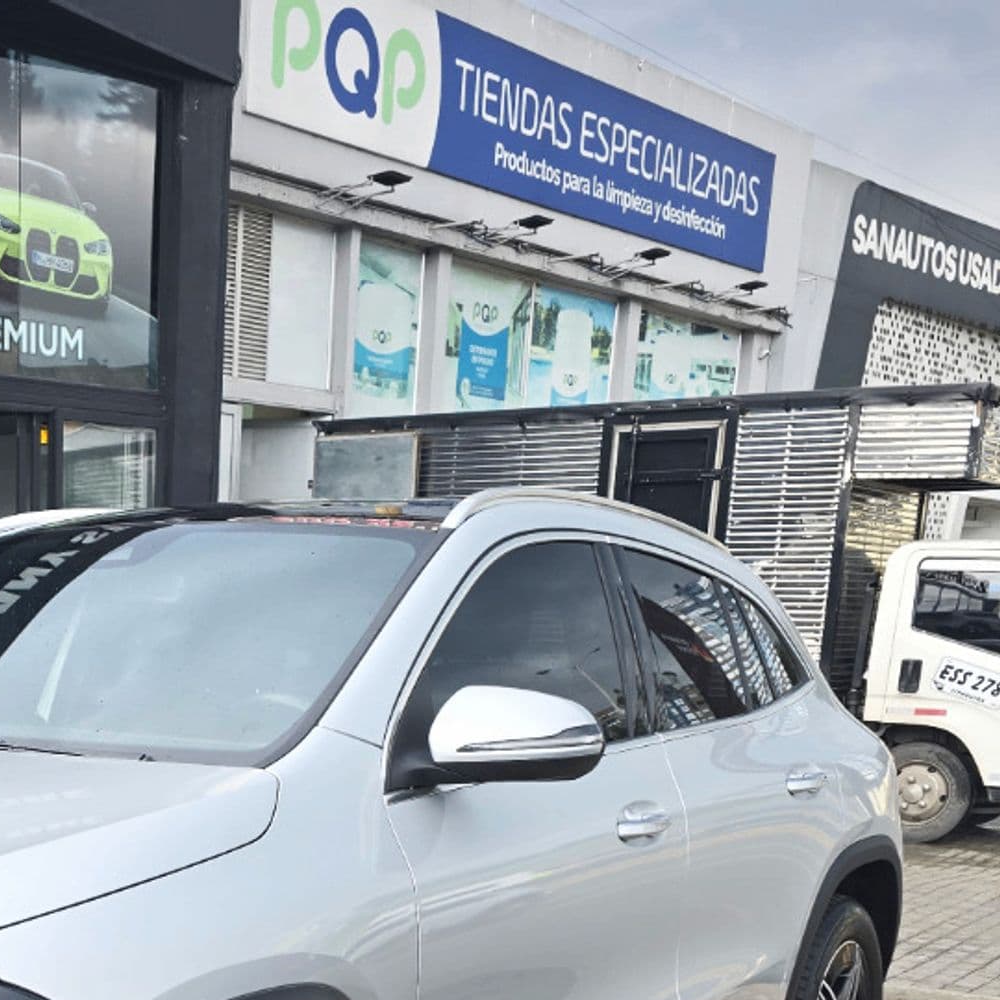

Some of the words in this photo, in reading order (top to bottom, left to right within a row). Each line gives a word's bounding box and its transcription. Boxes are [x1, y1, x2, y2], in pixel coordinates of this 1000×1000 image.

[455, 57, 574, 150] TIENDAS
[579, 110, 761, 217] ESPECIALIZADAS
[494, 141, 561, 187] Productos
[561, 170, 590, 195] para
[592, 174, 605, 200] la
[605, 179, 653, 214] limpieza
[653, 201, 663, 224] y
[661, 199, 726, 240] desinfección
[851, 213, 958, 283] SANAUTOS
[939, 664, 974, 685] ESS
